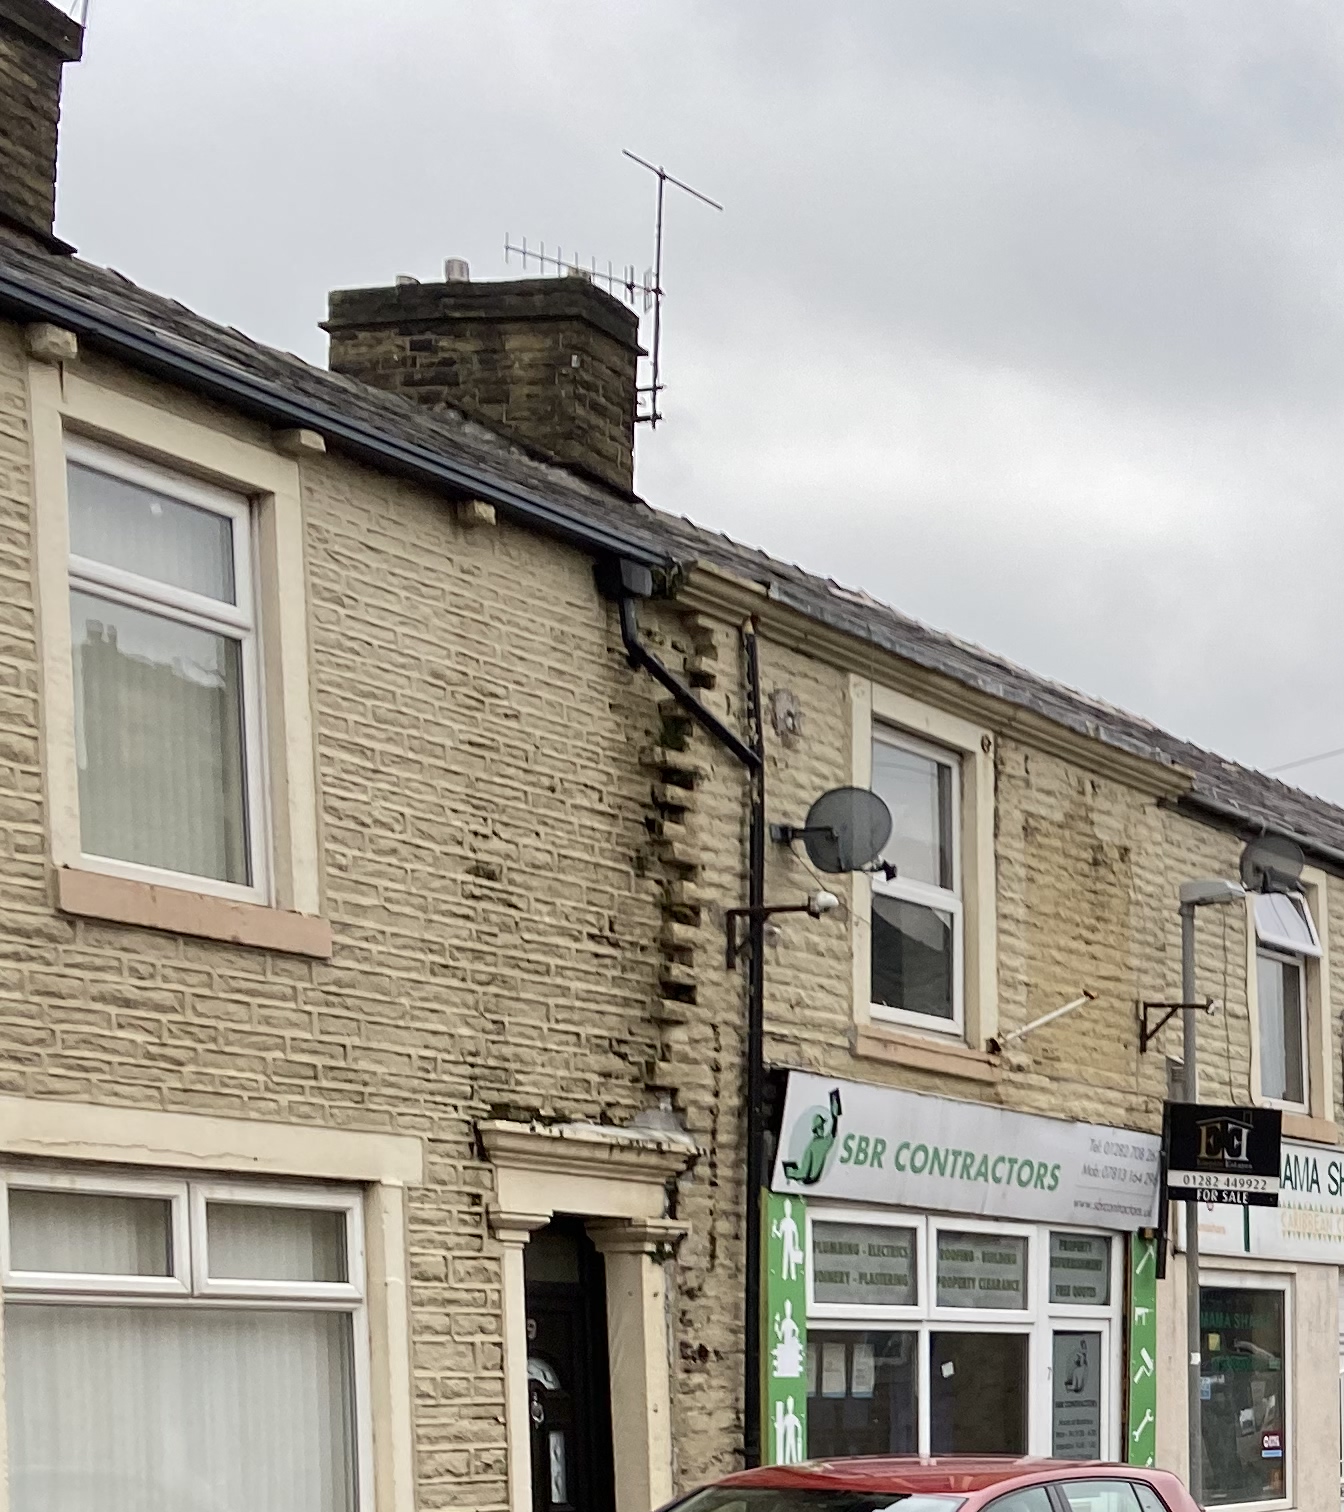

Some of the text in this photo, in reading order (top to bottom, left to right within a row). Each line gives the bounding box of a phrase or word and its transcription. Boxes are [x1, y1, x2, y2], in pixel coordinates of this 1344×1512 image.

[840, 1133, 1061, 1191] SBR CONTRACTORS
[1183, 1174, 1267, 1190] 01282 449922
[1196, 1188, 1249, 1205] FOR SALE
[1280, 1211, 1333, 1233] CARIBBEAN
